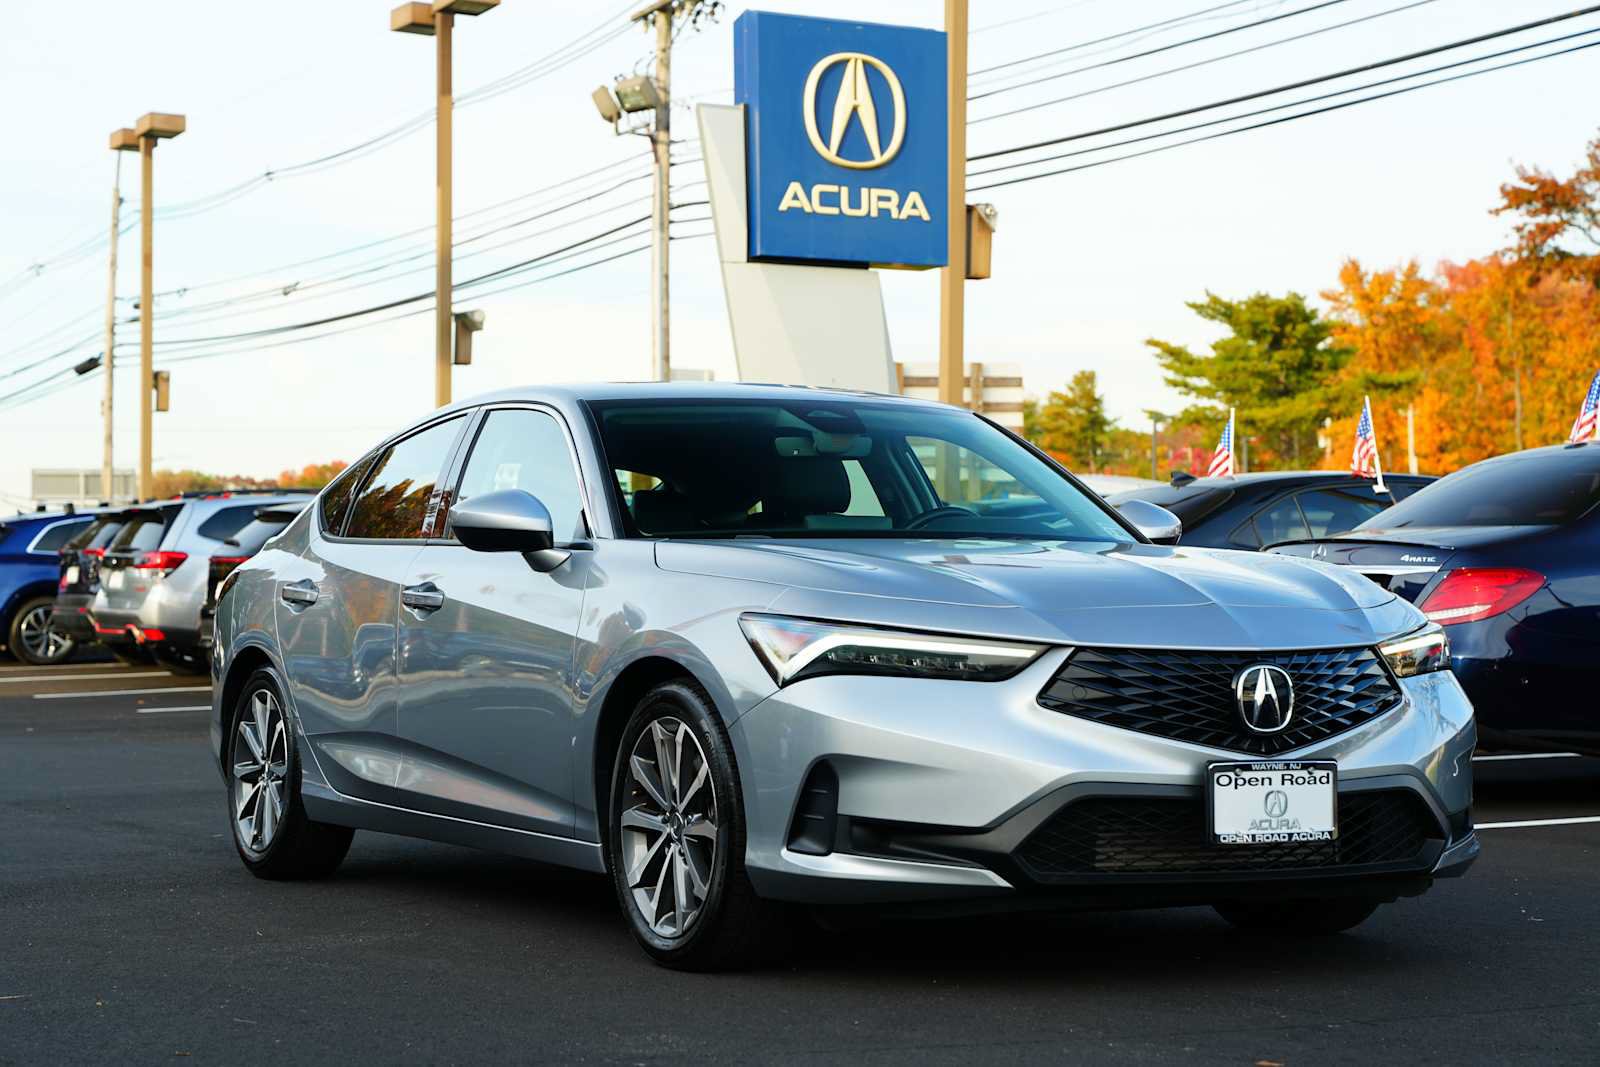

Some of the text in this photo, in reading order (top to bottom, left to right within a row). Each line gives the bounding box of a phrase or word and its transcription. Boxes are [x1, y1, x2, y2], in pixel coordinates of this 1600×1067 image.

[778, 181, 931, 221] ACURA
[1400, 554, 1437, 563] 4MATIC
[1216, 773, 1330, 789] Open Road
[1248, 818, 1300, 831] ACURA
[1220, 831, 1331, 843] OPEN ROAD ACURA
